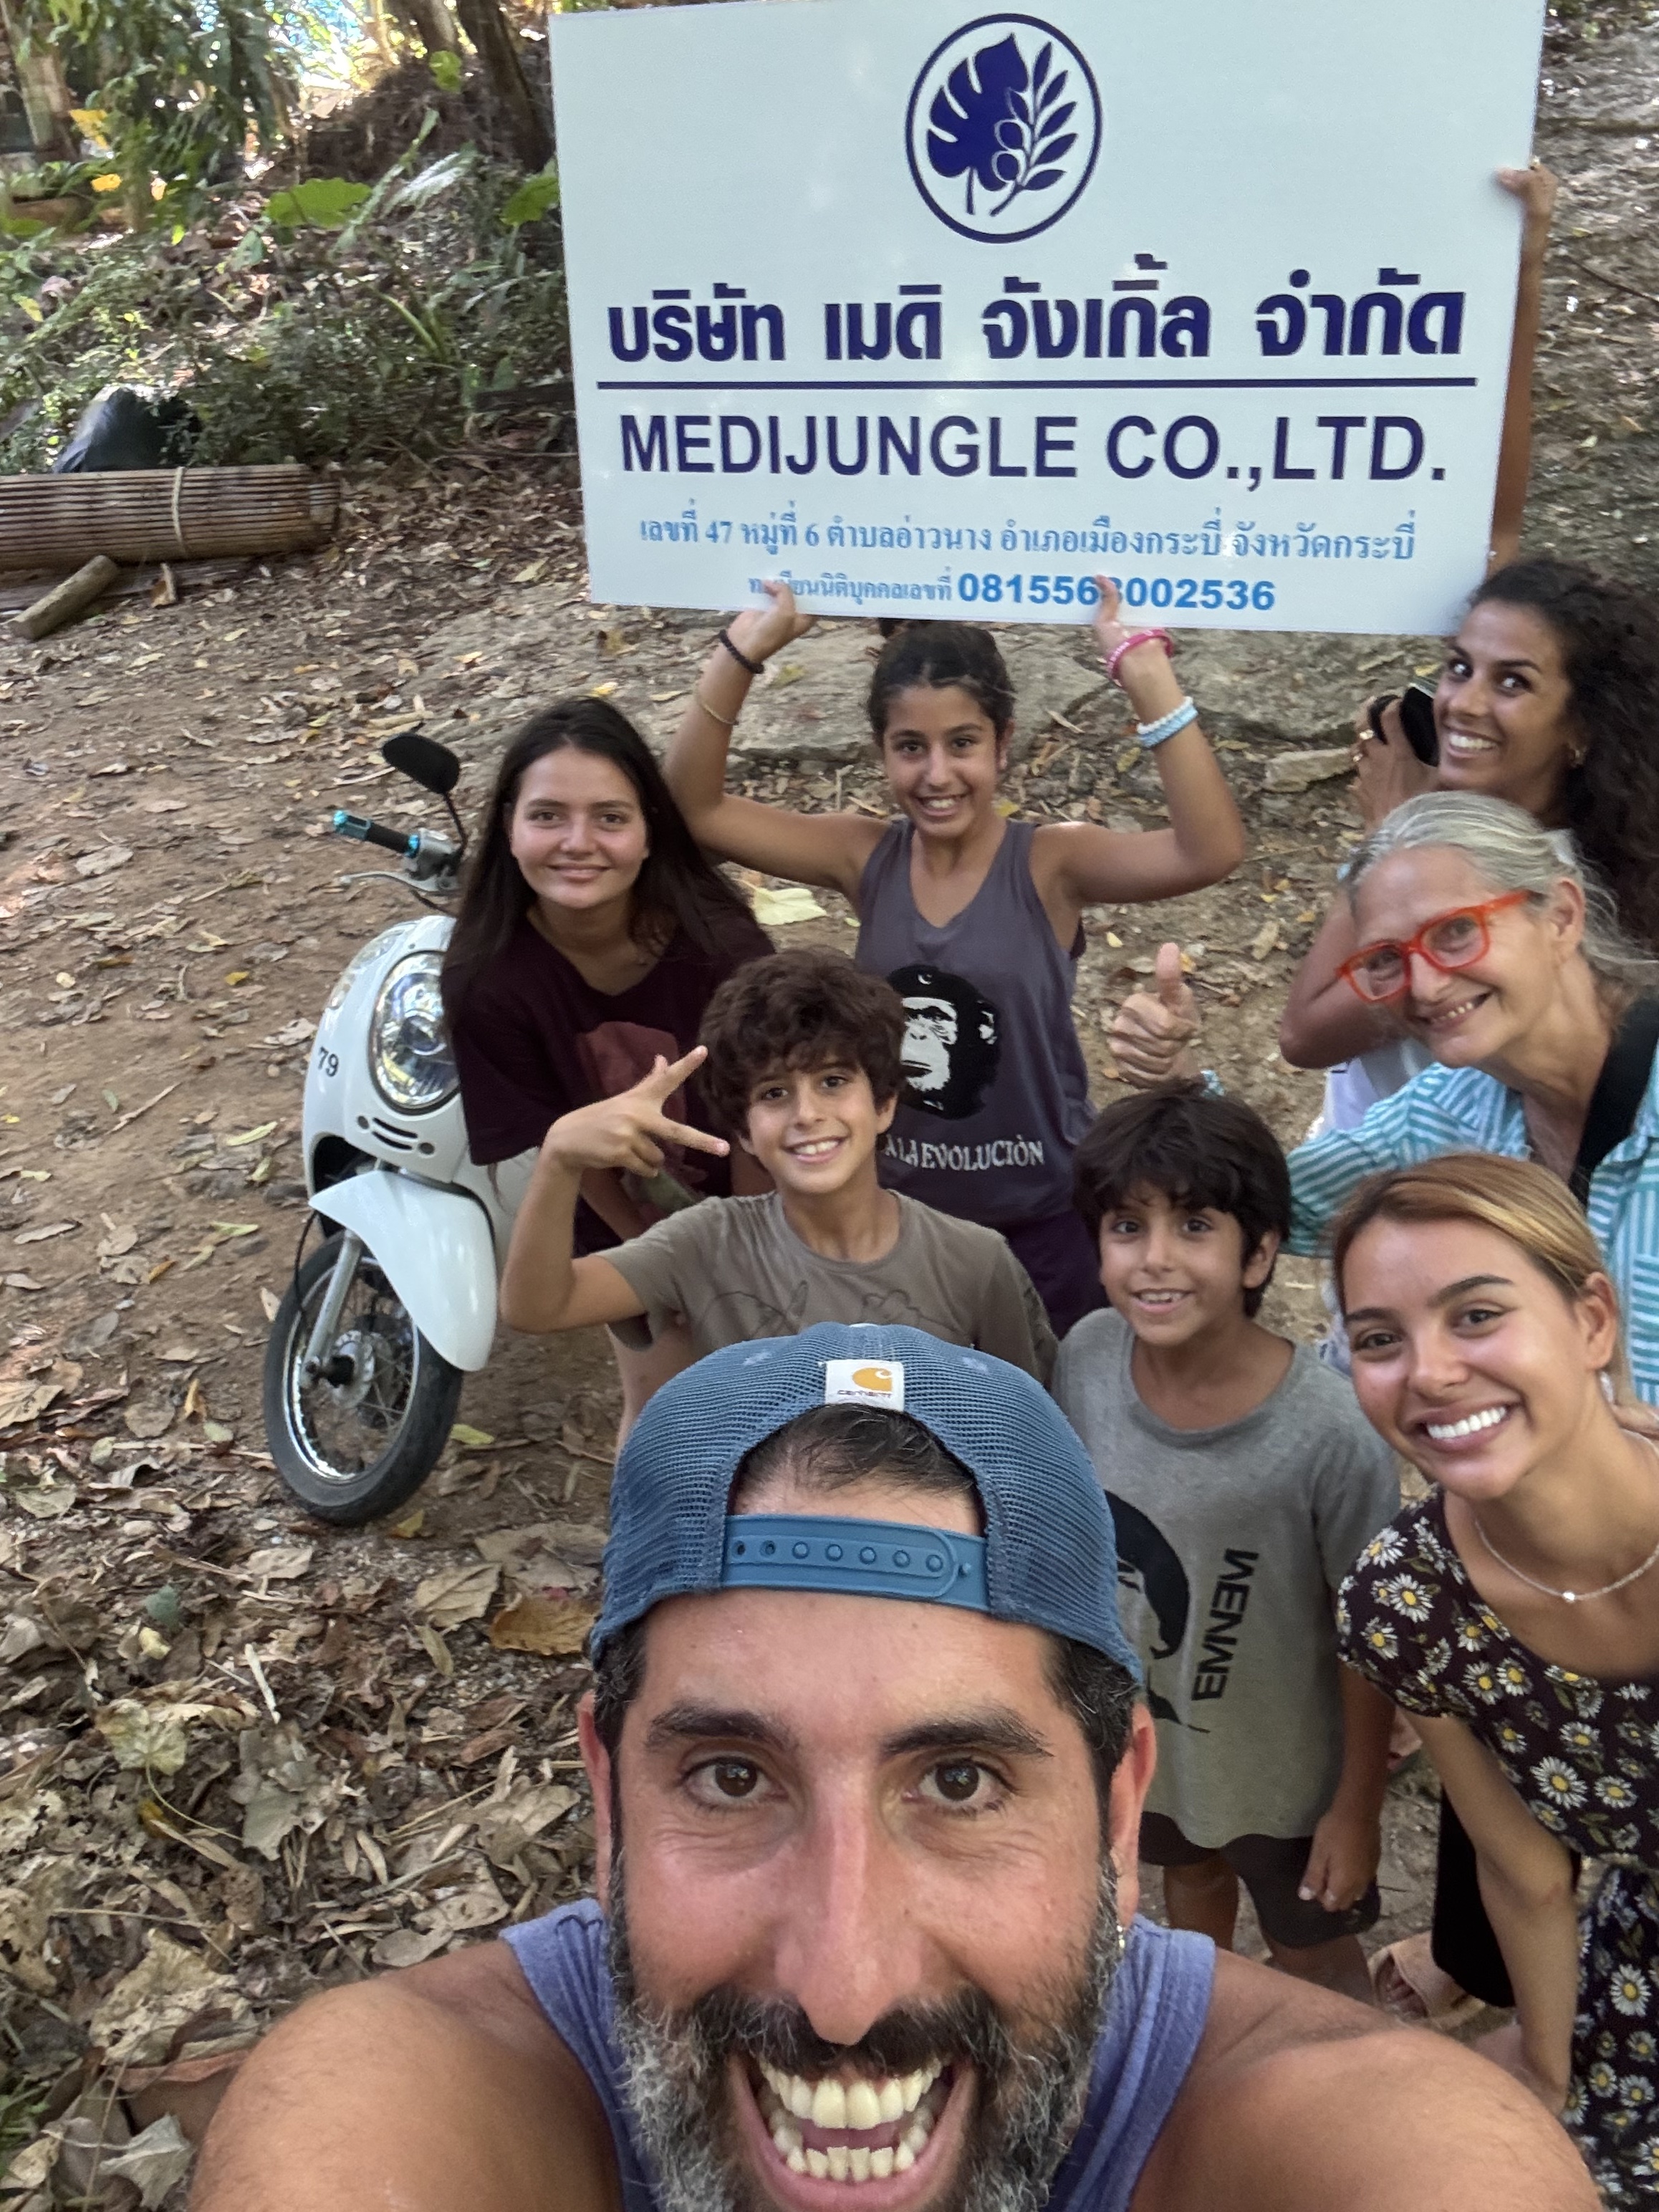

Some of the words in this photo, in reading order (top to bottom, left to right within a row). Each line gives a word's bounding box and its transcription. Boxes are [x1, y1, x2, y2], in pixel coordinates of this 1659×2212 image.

[607, 282, 786, 362] บริษัท
[824, 284, 942, 361] เมดิ
[981, 253, 1211, 360] จังเกิ้ล
[1255, 268, 1466, 357] จำกัด
[620, 415, 1077, 478] MEDIJUNGLE
[1106, 415, 1446, 492] CO.,LTD.
[640, 497, 699, 543] เลขที่
[705, 520, 734, 544] 47
[740, 500, 798, 555] หมู่ที่
[804, 523, 820, 547] 6
[826, 514, 992, 551] ตำบลอ่าวนาง
[1000, 506, 1222, 556] อำเภอเมืองกระบี่
[1231, 509, 1416, 560] จังหวัดกระบี่
[317, 1047, 340, 1077] 79
